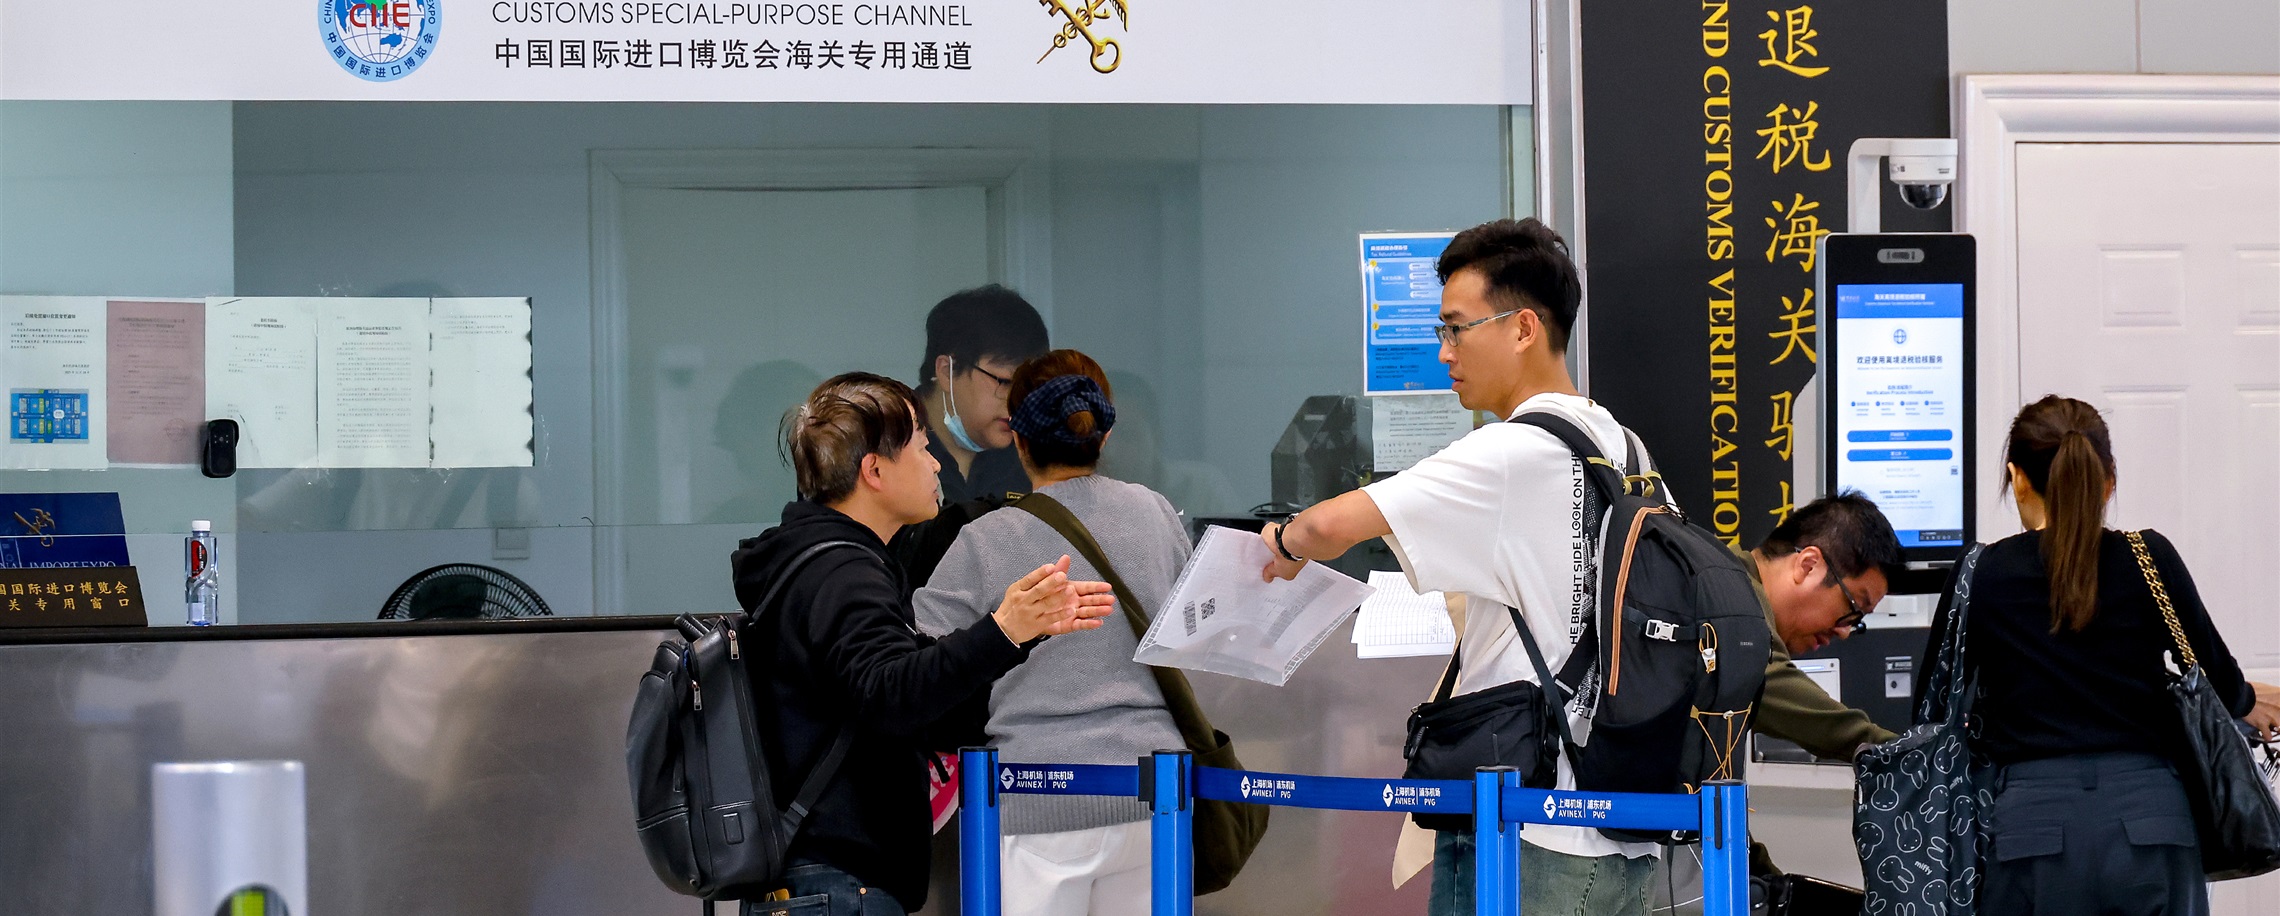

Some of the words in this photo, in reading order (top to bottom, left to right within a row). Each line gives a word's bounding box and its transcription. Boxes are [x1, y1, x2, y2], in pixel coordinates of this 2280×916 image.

[349, 3, 410, 28] CIIE
[492, 1, 614, 24] CUSTOMS
[621, 2, 844, 26] SPECIAL-PURPOSE
[854, 4, 973, 26] CHANNEL
[327, 32, 434, 78] 中国国际进口博览会
[495, 37, 973, 70] 中国国际进口博览会海关专用通道
[1703, 65, 1735, 261] CUSTOMS
[1755, 5, 1832, 528] 退税海关
[1573, 478, 1583, 498] ON
[1571, 501, 1582, 539] LOOK
[1572, 541, 1583, 572] SIDE
[1570, 574, 1583, 624] BRIGHT
[1569, 626, 1580, 645] HE
[1016, 780, 1043, 789] AVINEX
[1052, 781, 1068, 789] PVG
[1252, 789, 1273, 798] AVINEX
[1280, 790, 1292, 799] PVG
[1395, 797, 1416, 806] AVINEX
[1424, 798, 1436, 806] PVG
[1558, 809, 1583, 819] AVINEX
[1592, 810, 1606, 820] PVG
[1914, 860, 1933, 876] miffy
